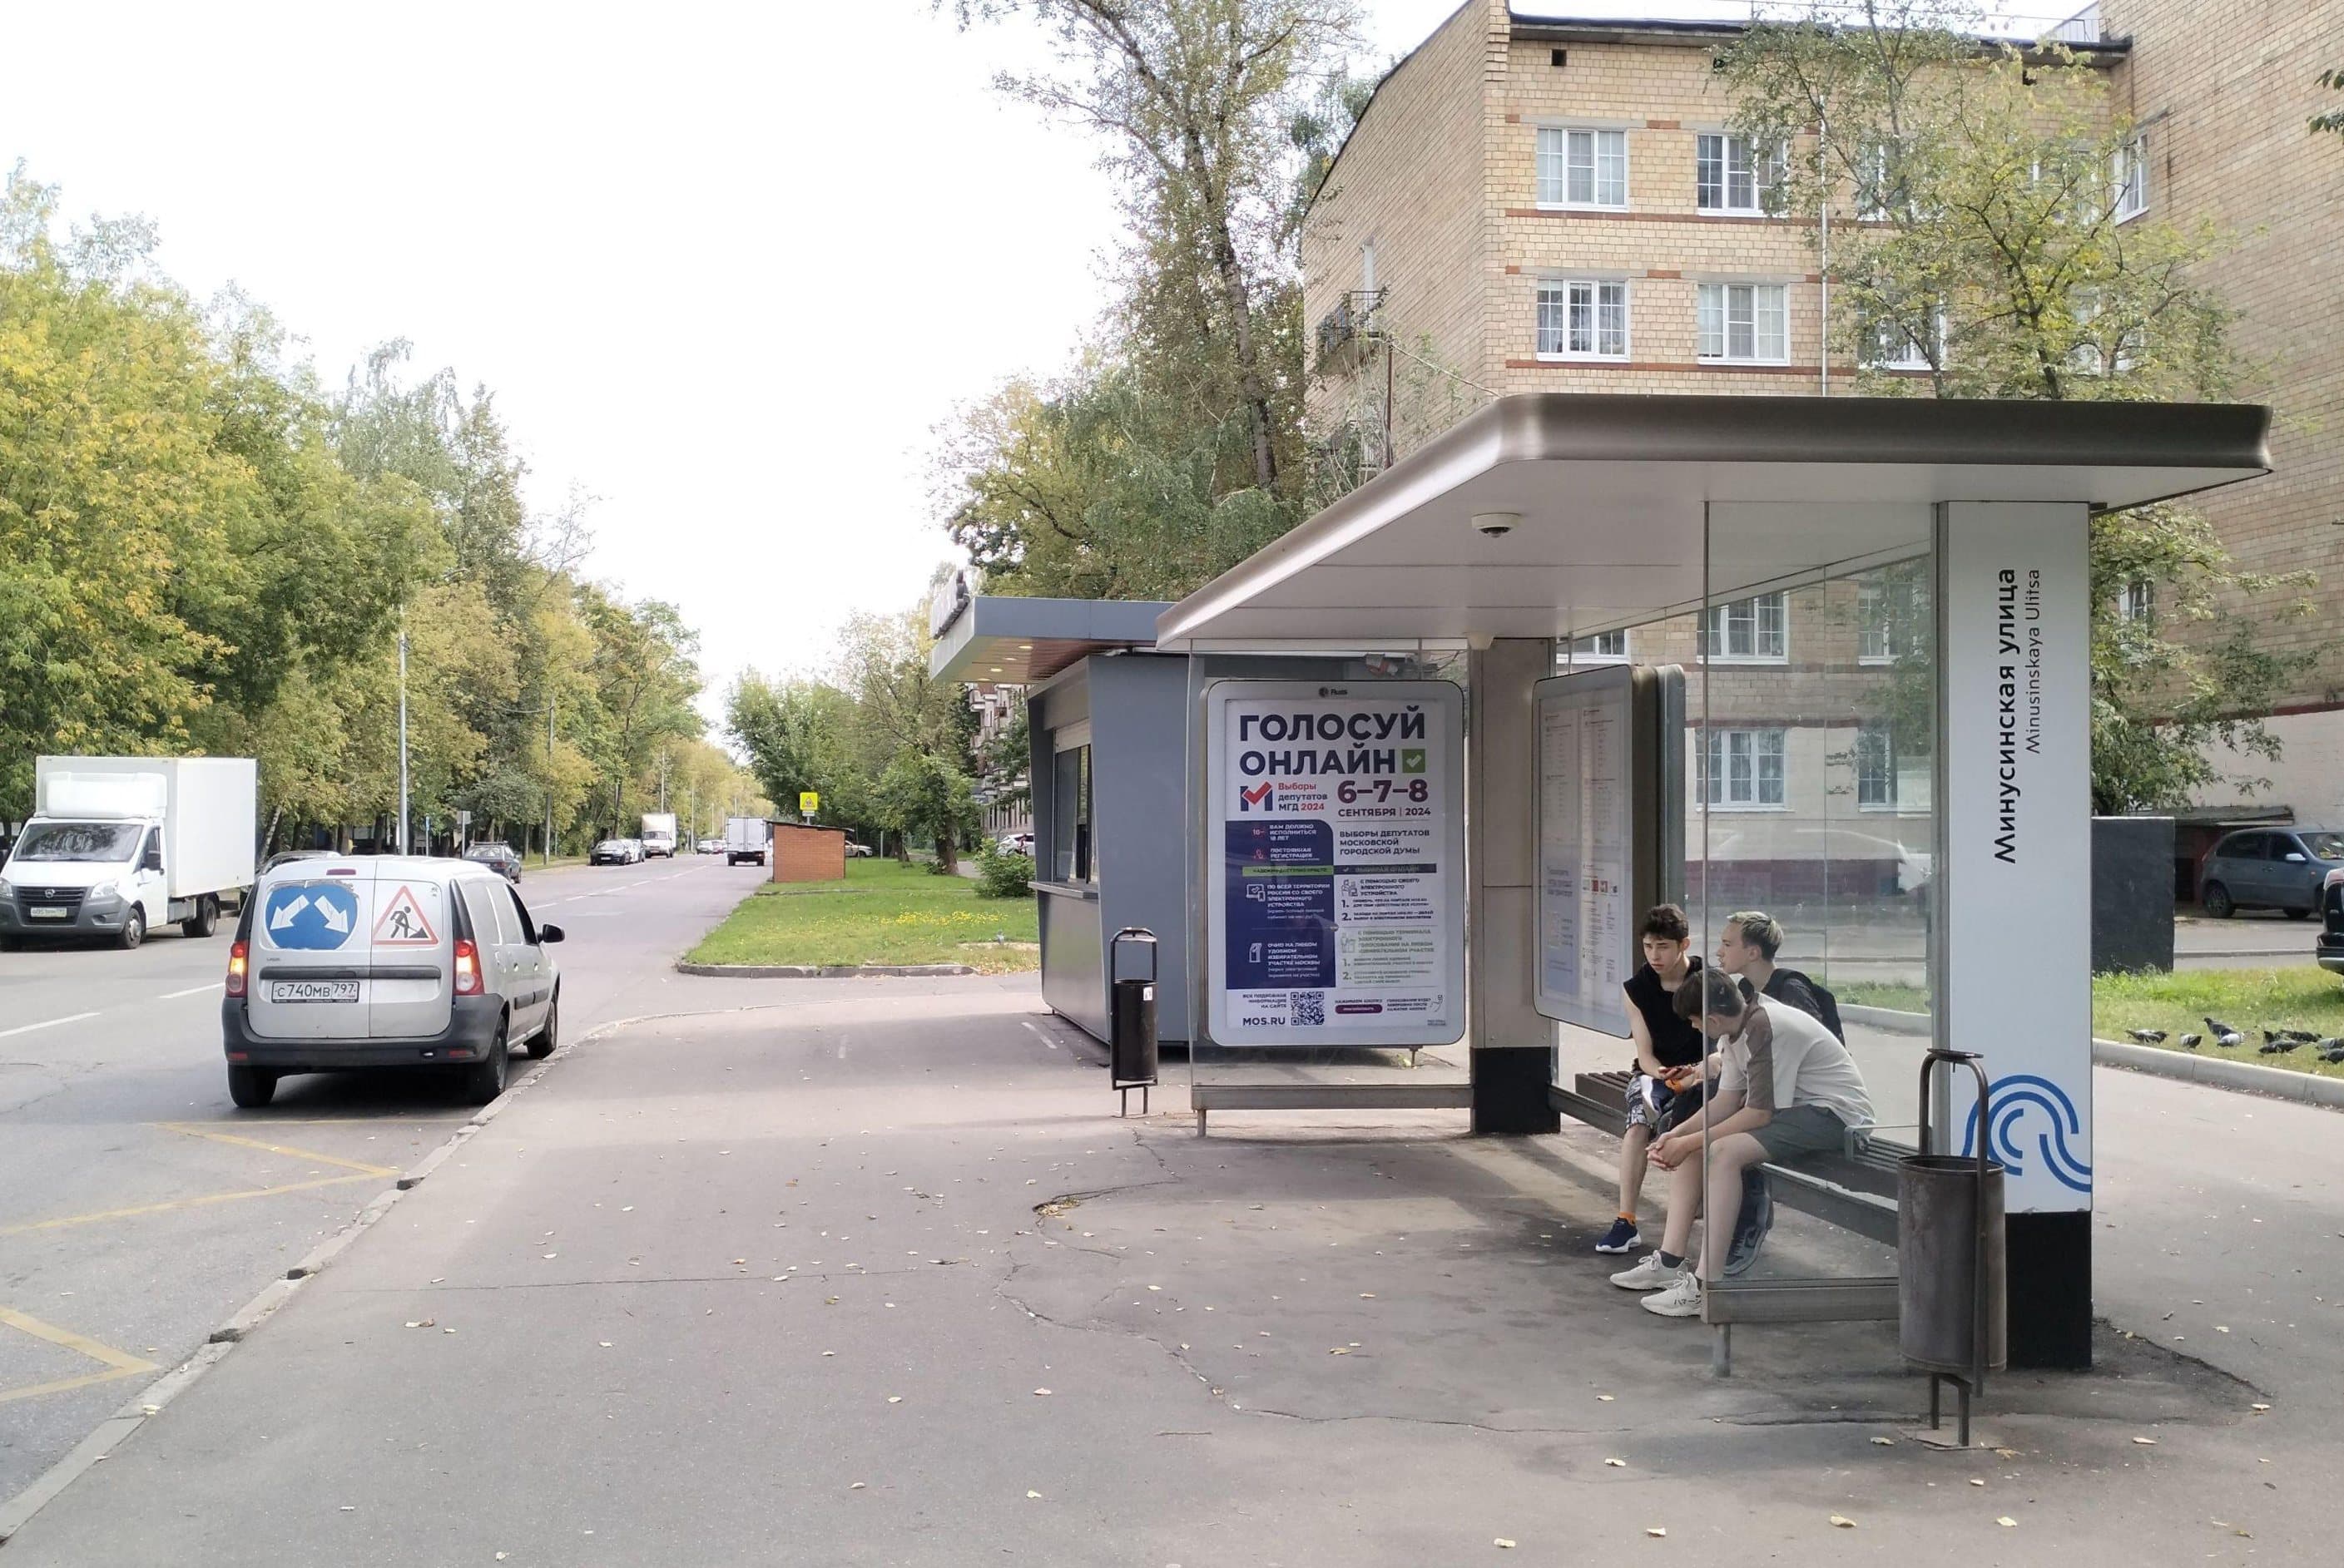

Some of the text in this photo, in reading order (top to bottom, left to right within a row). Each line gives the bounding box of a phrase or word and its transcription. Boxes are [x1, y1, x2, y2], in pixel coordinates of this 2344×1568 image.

[2025, 569, 2044, 754] Minusinskaya Ulitsa
[1995, 568, 2020, 864] Минусинская улица
[1240, 705, 1425, 741] ГОЛОСУЙ
[1239, 742, 1395, 776] ОНЛАЙН
[1278, 782, 1316, 790] Выборы
[1278, 793, 1328, 803] депутатов
[1278, 803, 1325, 813] МГД 2024
[1338, 807, 1431, 817] СЕНТЯБРЯ 2024
[1380, 829, 1430, 838] ДЕПУТАТОВ
[1340, 838, 1399, 846] МОСКОВСКОЙ
[1340, 847, 1391, 855] ГОРОДСКОЙ
[1242, 1017, 1286, 1026] MOS.RU
